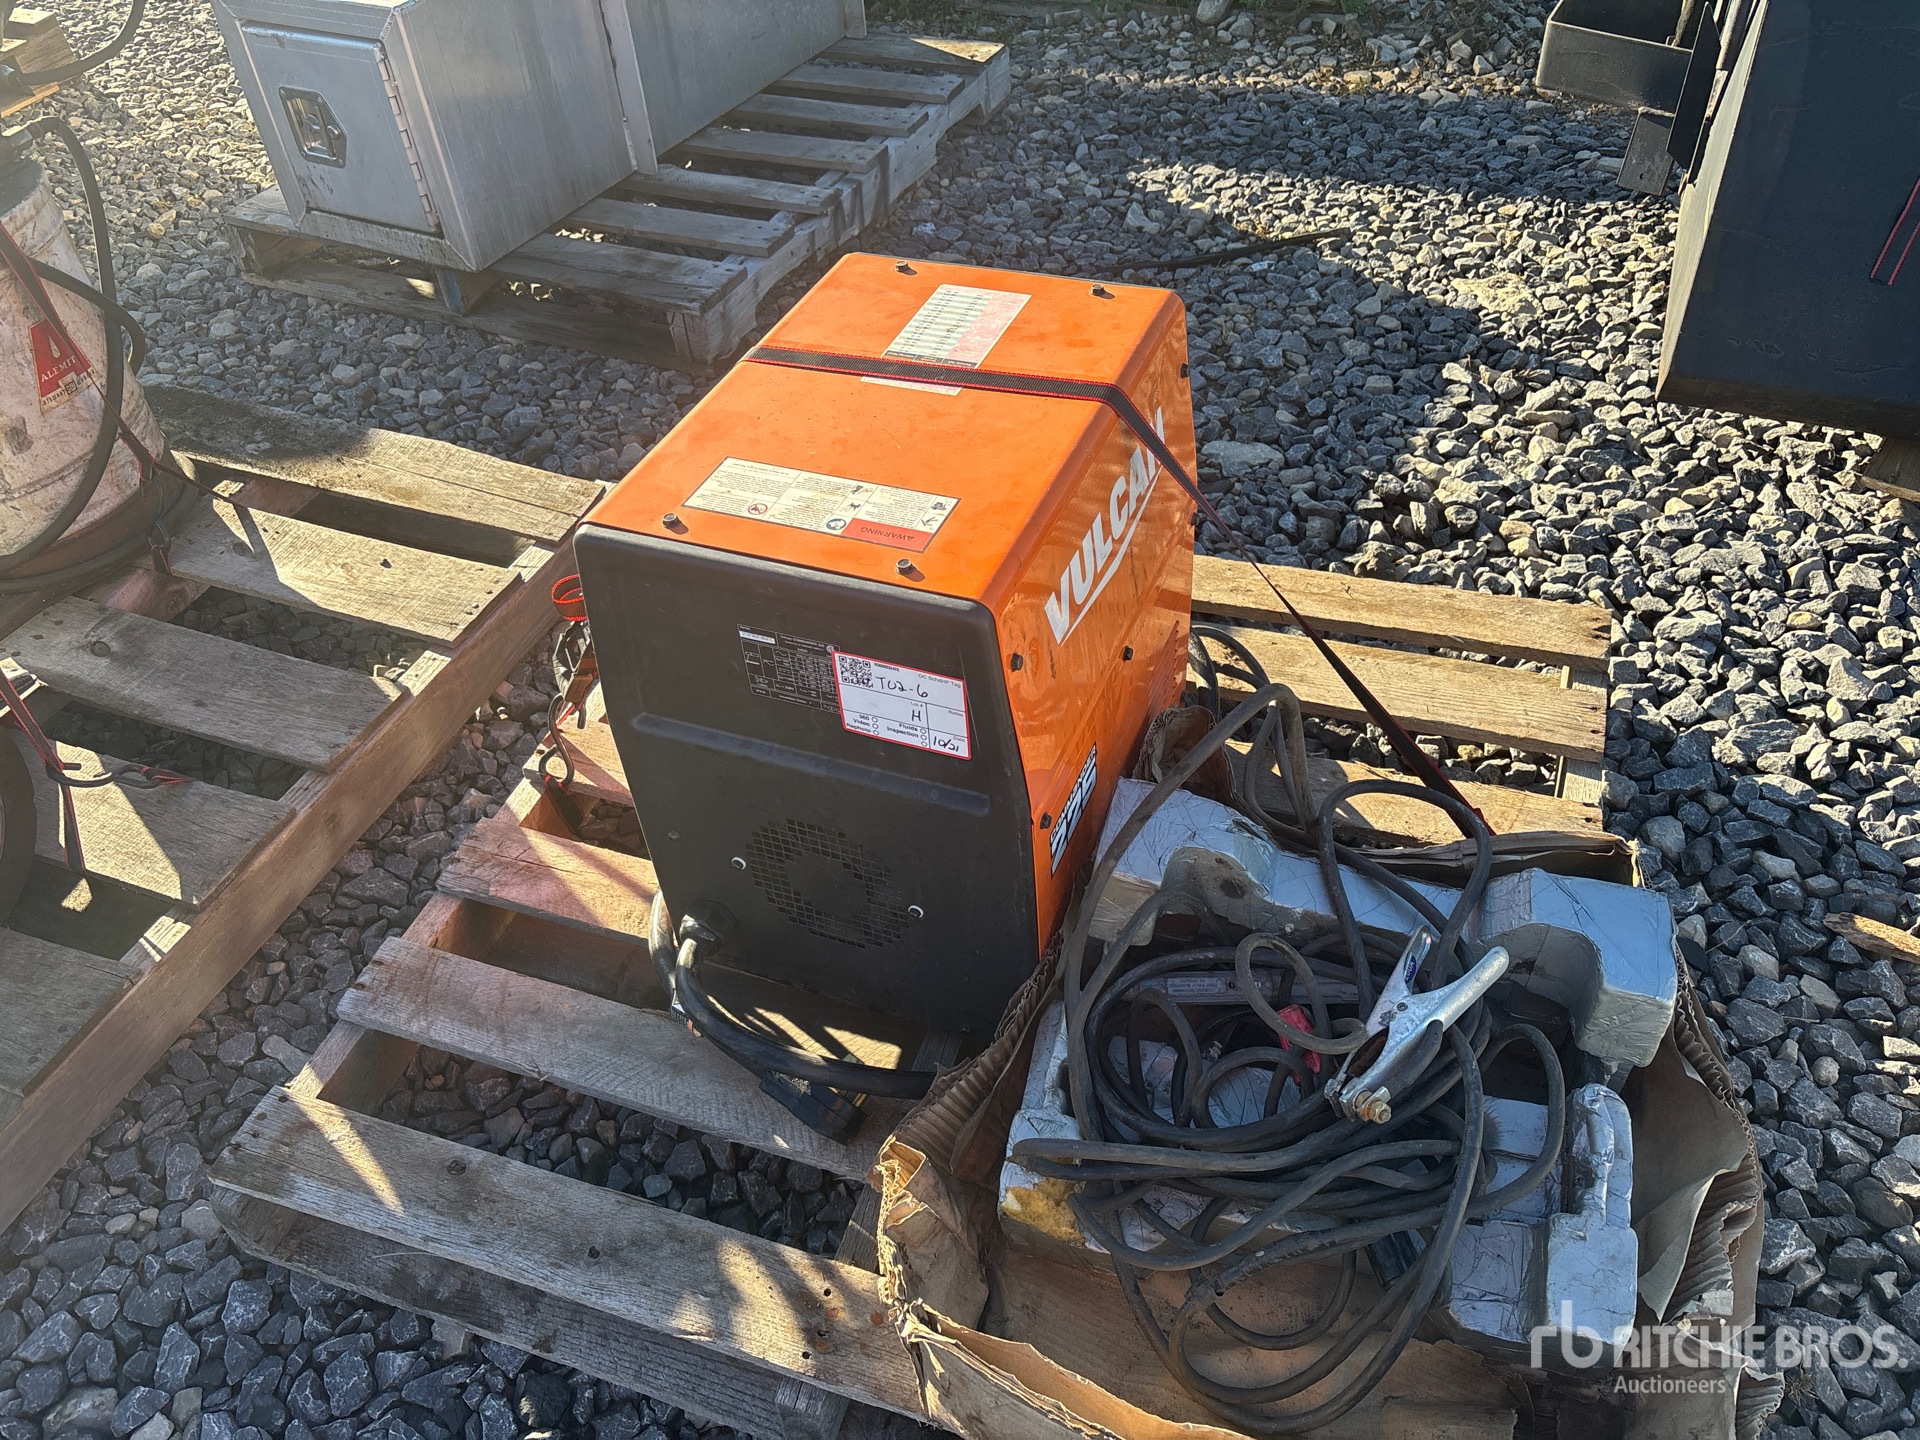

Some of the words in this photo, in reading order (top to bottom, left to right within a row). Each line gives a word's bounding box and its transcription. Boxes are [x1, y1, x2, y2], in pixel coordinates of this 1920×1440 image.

[40, 355, 76, 382] ALEMIT
[860, 525, 905, 541] WARNING
[853, 718, 871, 727] Video
[911, 709, 922, 722] H
[886, 726, 919, 739] Inspection
[898, 723, 918, 732] Fluids
[933, 736, 960, 753] 10/21
[1052, 754, 1097, 876] 225
